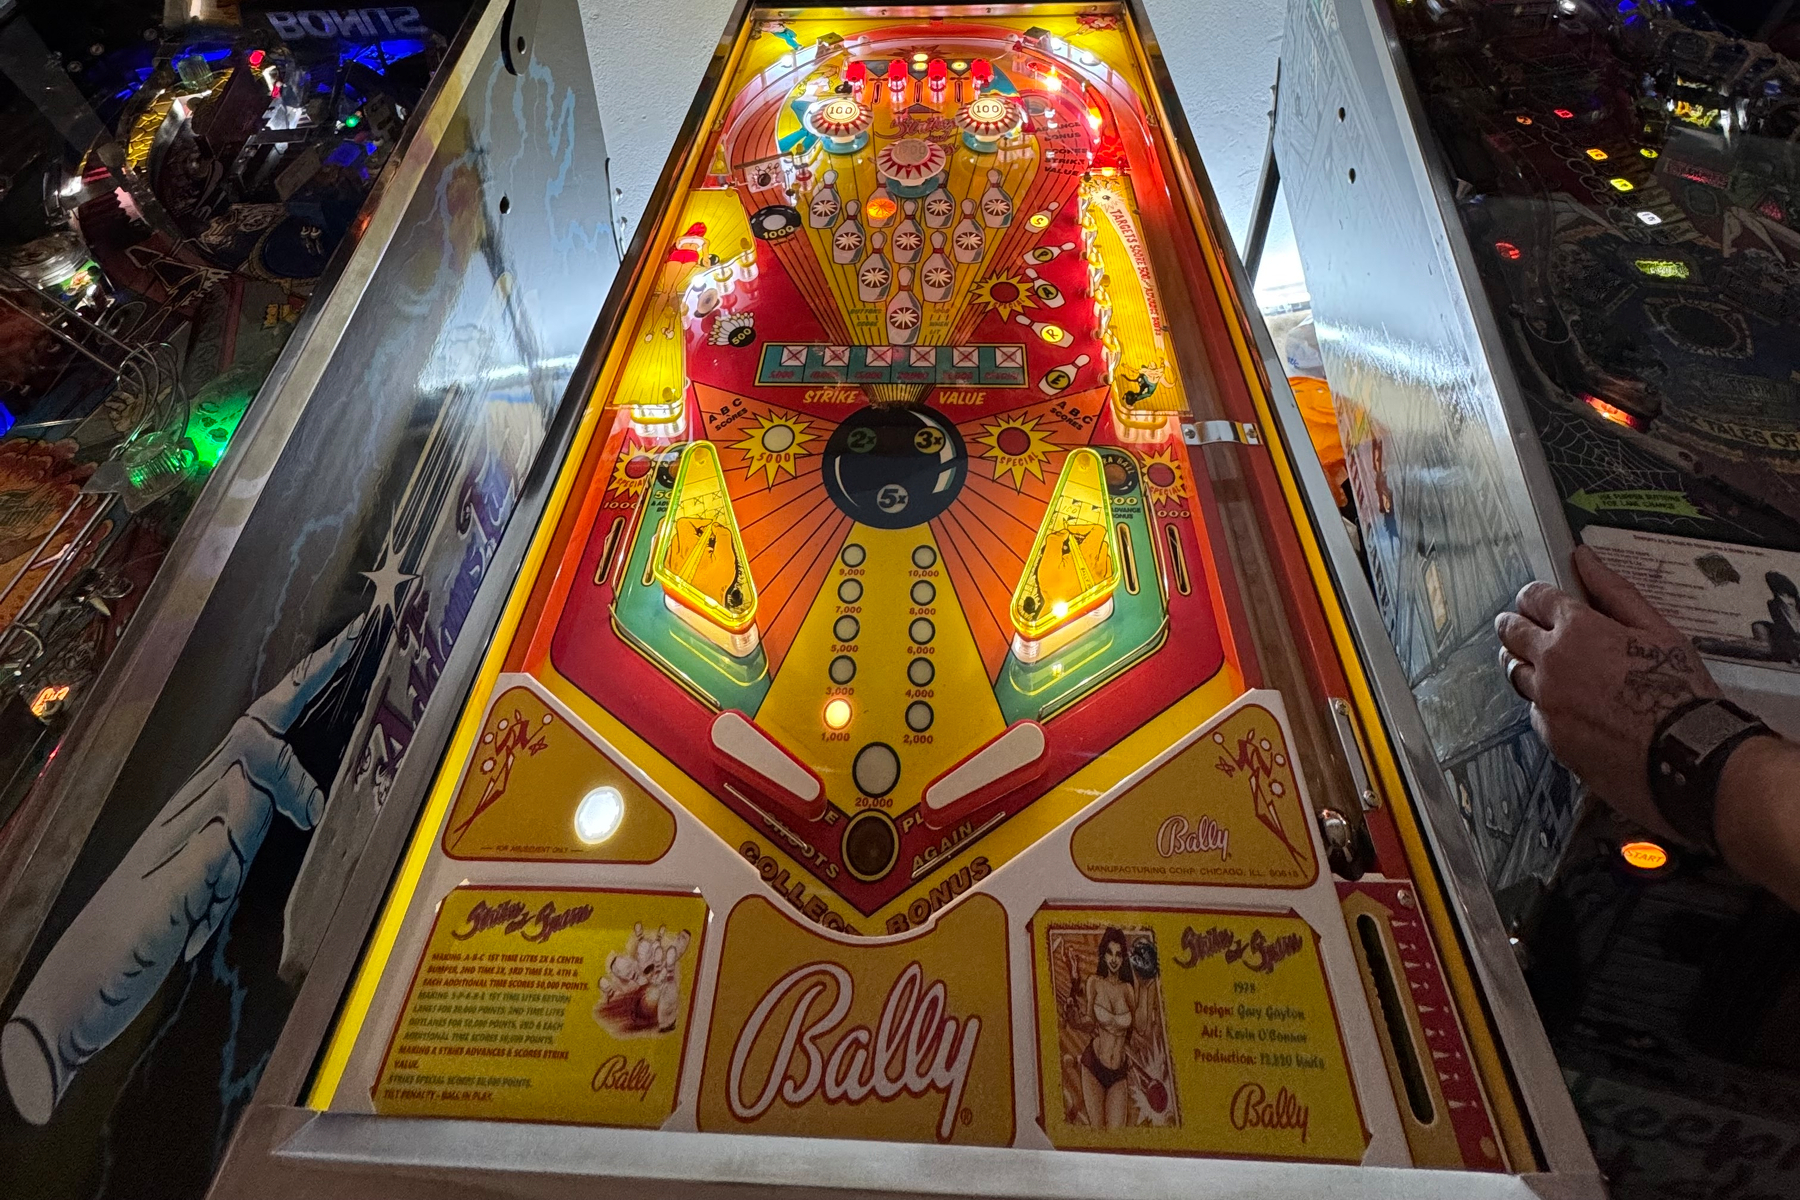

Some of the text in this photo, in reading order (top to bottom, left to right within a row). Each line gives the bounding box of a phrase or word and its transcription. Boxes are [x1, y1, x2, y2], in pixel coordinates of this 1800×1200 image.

[829, 106, 852, 114] 100
[976, 105, 999, 113] 100
[1044, 166, 1080, 176] VALUE
[1110, 209, 1137, 243] TARGETS
[763, 226, 794, 239] 1000
[1043, 287, 1054, 297] A
[732, 329, 752, 345] 500
[1047, 330, 1059, 340] R
[1053, 375, 1066, 385] E
[803, 390, 987, 406] STRIKE VALUE
[716, 407, 749, 431] SCORES
[1050, 408, 1084, 431] SCORES
[756, 452, 791, 464] 5000
[998, 452, 1040, 466] SPECIAL
[1117, 456, 1134, 474] BALL
[1149, 485, 1187, 496] SPECIAL
[839, 568, 865, 576] 9,000
[835, 606, 862, 614] 7,000
[909, 608, 936, 616] 8,000
[831, 645, 858, 653] 5,000
[907, 646, 935, 655] 6,000
[826, 687, 854, 695] 3,000
[905, 689, 934, 698] 4,000
[821, 733, 850, 742] 1,000
[903, 735, 933, 744] 2,000
[855, 798, 893, 808] 20,000
[1156, 814, 1229, 862] Bally
[911, 821, 975, 872] AGAIN
[1626, 850, 1665, 863] START
[1087, 864, 1166, 874] MANUFACTURING
[886, 857, 993, 935] BONUS
[501, 954, 518, 962] TIME
[519, 955, 538, 963] LITES
[539, 955, 549, 963] 2X
[556, 956, 584, 964] CENTRE
[460, 966, 475, 974] 2ND
[477, 966, 495, 974] TIME
[525, 968, 542, 976] TIME
[556, 969, 571, 977] 4TH
[423, 978, 442, 986] EACH
[443, 978, 487, 987] ADDITIONAL
[489, 979, 506, 988] TIME
[508, 980, 534, 989] SCORES
[1194, 1002, 1234, 1018] Design:
[1201, 1026, 1222, 1039] Art:
[725, 960, 982, 1142] Bally
[1194, 1049, 1257, 1065] Production:
[591, 1054, 657, 1102] Bally
[1230, 1082, 1309, 1144] Bally
